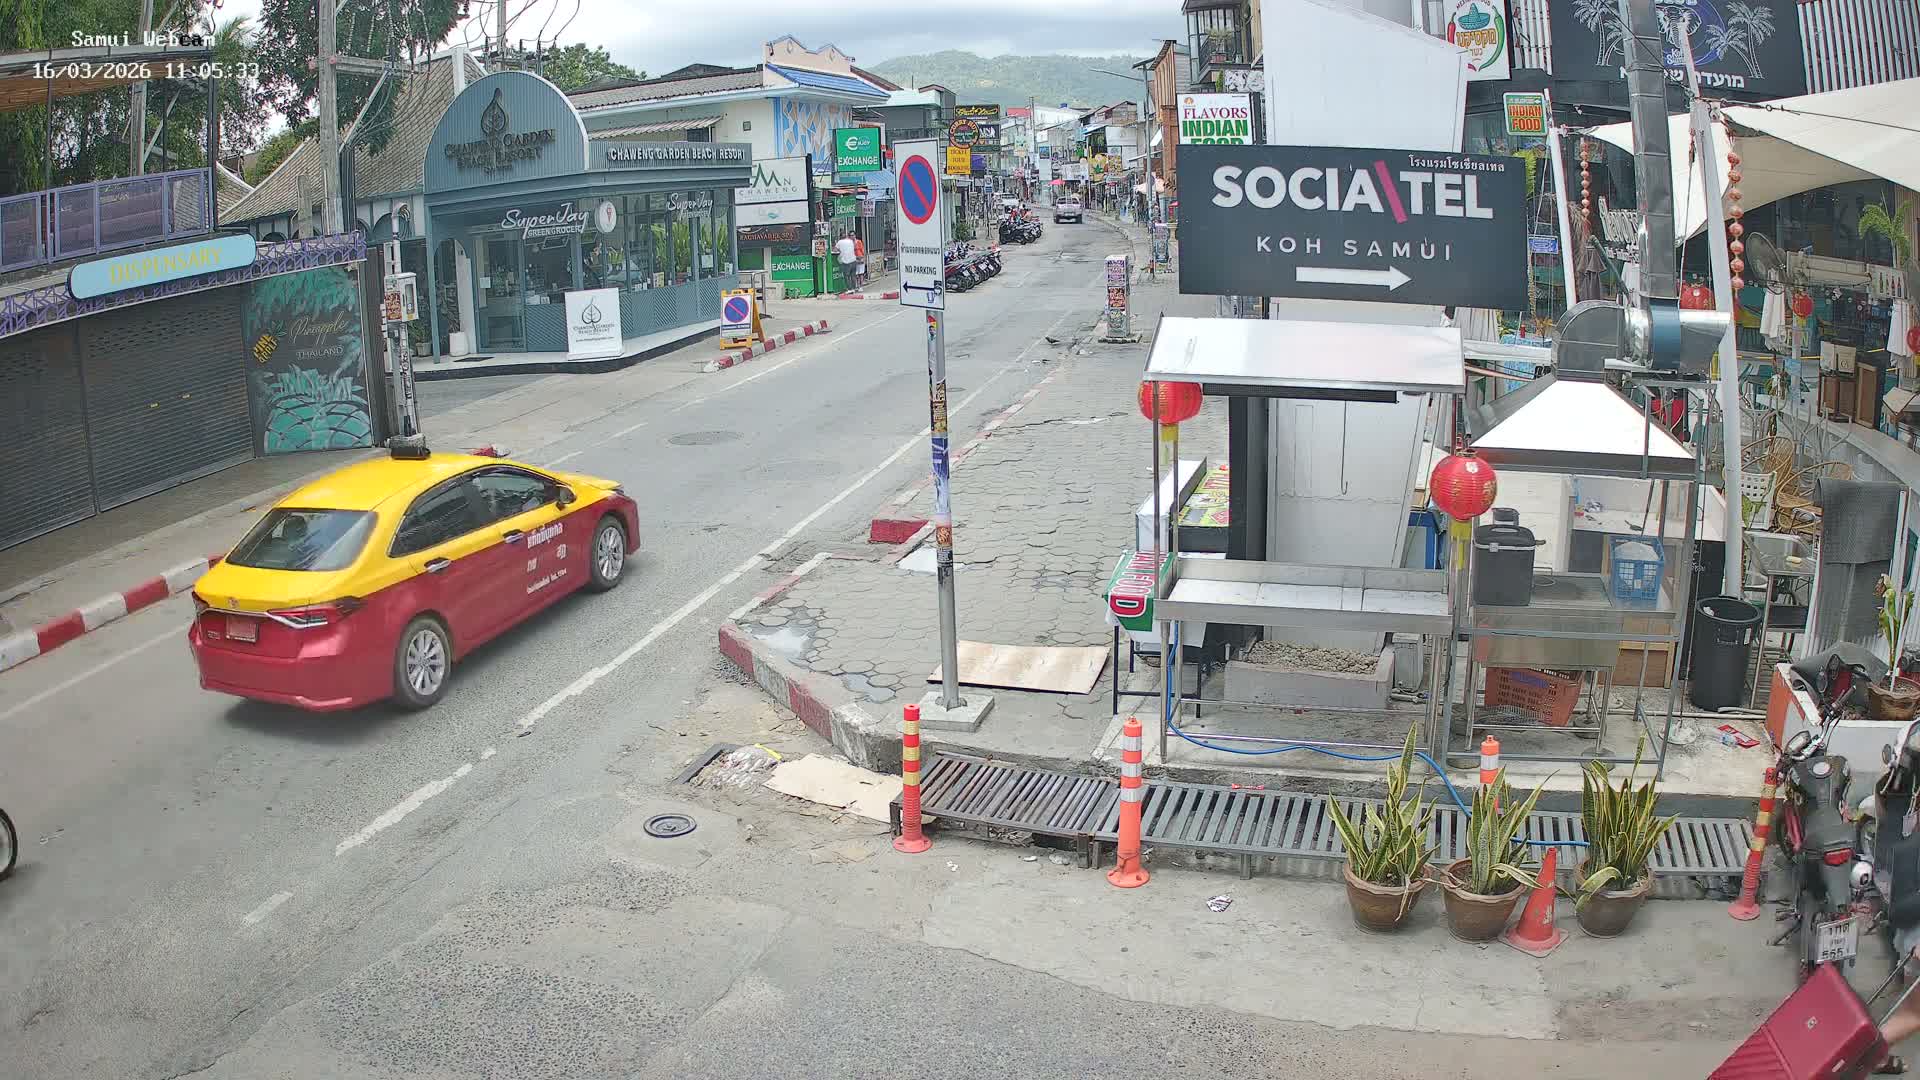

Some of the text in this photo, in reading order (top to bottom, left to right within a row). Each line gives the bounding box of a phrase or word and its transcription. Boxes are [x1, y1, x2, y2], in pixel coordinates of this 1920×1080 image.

[1184, 107, 1248, 120] FLAVORS
[1508, 105, 1542, 117] INDIAN
[1182, 119, 1249, 137] INDIAN
[1512, 118, 1541, 131] FOOD
[503, 129, 555, 147] GARDEN
[610, 147, 745, 161] CHAWENG GARDEN BEACH RESORT
[838, 156, 878, 166] EXCHANGE
[1408, 154, 1505, 172] โรงแรมโซเชียลเทล
[739, 187, 798, 196] CHAWENG
[1256, 235, 1451, 261] KOH SAMUI
[110, 247, 222, 286] DISPENSARY
[772, 262, 811, 271] EXCHANGE
[905, 265, 937, 275] NO PARKING
[296, 345, 344, 360] THAILAND
